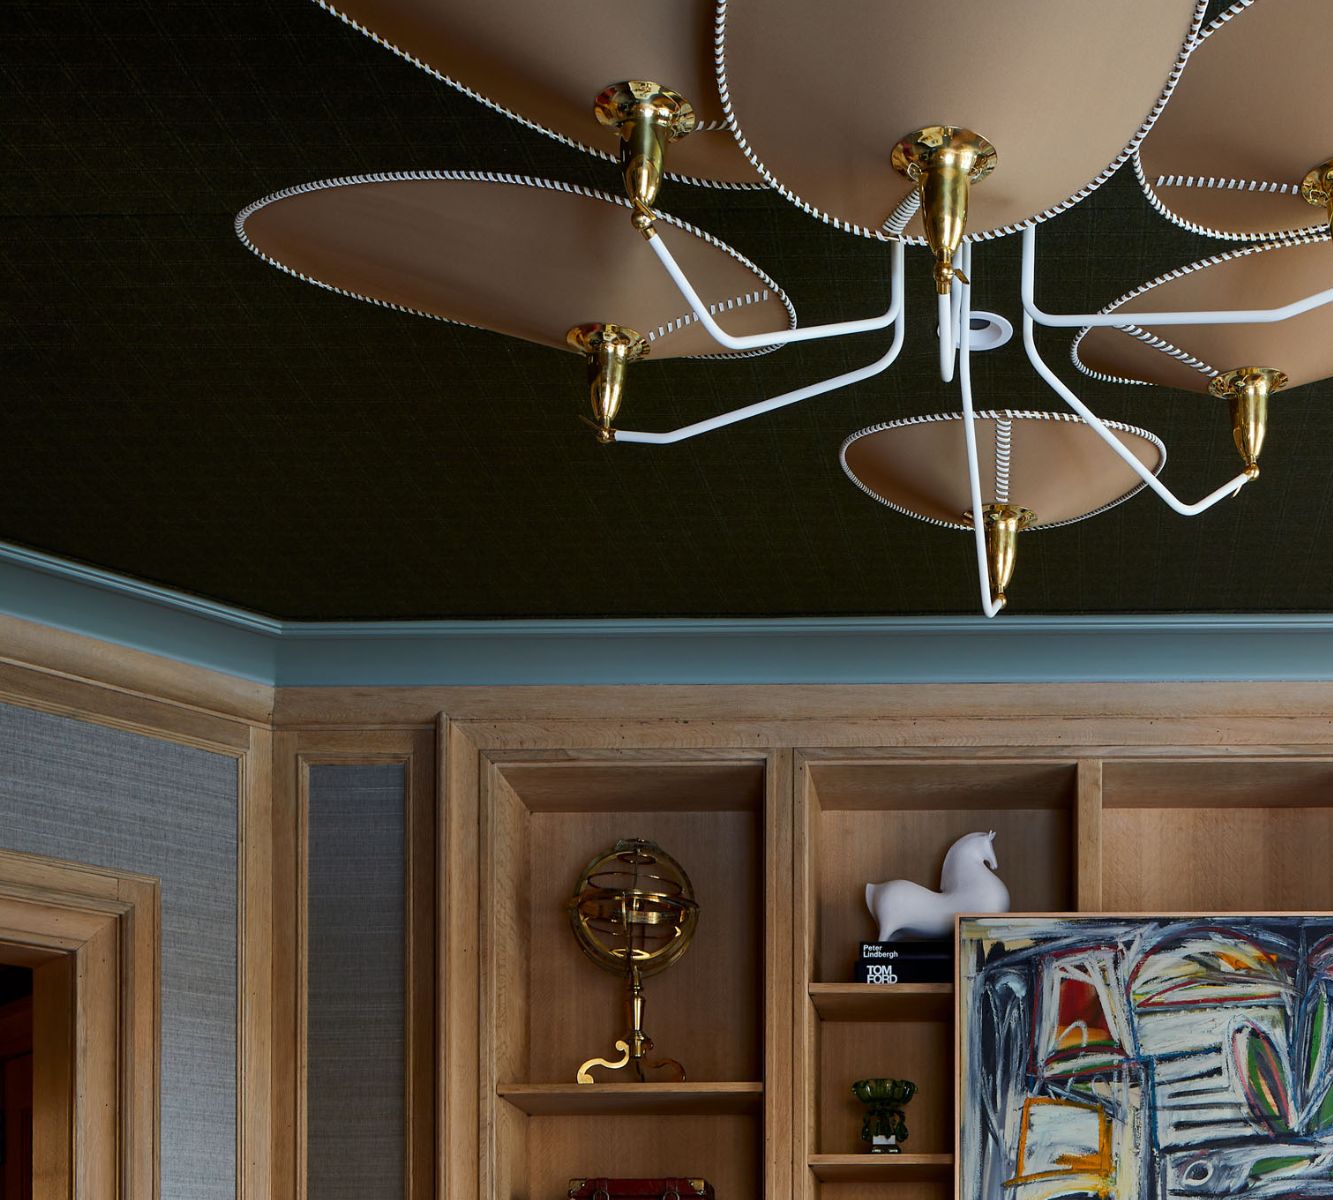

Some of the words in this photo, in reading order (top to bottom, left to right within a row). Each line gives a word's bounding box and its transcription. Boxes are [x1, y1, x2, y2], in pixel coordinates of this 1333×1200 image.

[863, 944, 883, 952] Peter
[863, 951, 898, 959] Lindbergh
[866, 965, 893, 975] TOM
[867, 974, 898, 984] FORD
